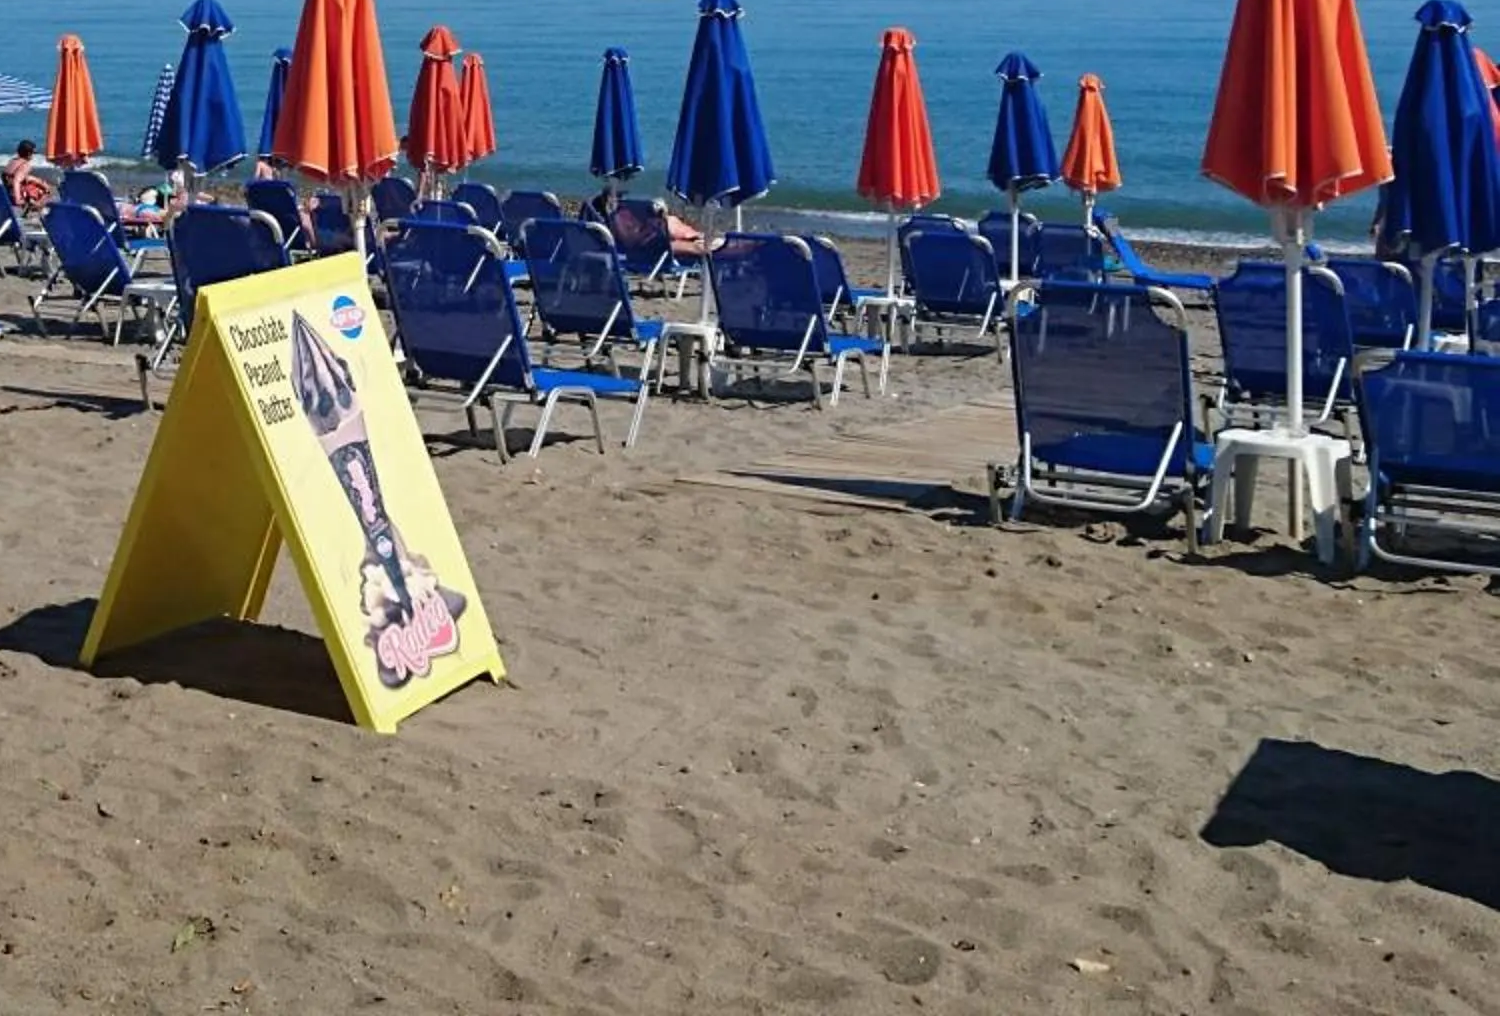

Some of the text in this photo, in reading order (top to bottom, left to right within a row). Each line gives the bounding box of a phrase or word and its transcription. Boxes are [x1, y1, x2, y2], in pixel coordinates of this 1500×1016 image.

[230, 316, 288, 352] Chocolate
[244, 355, 286, 388] Peanut
[258, 394, 294, 425] Butter
